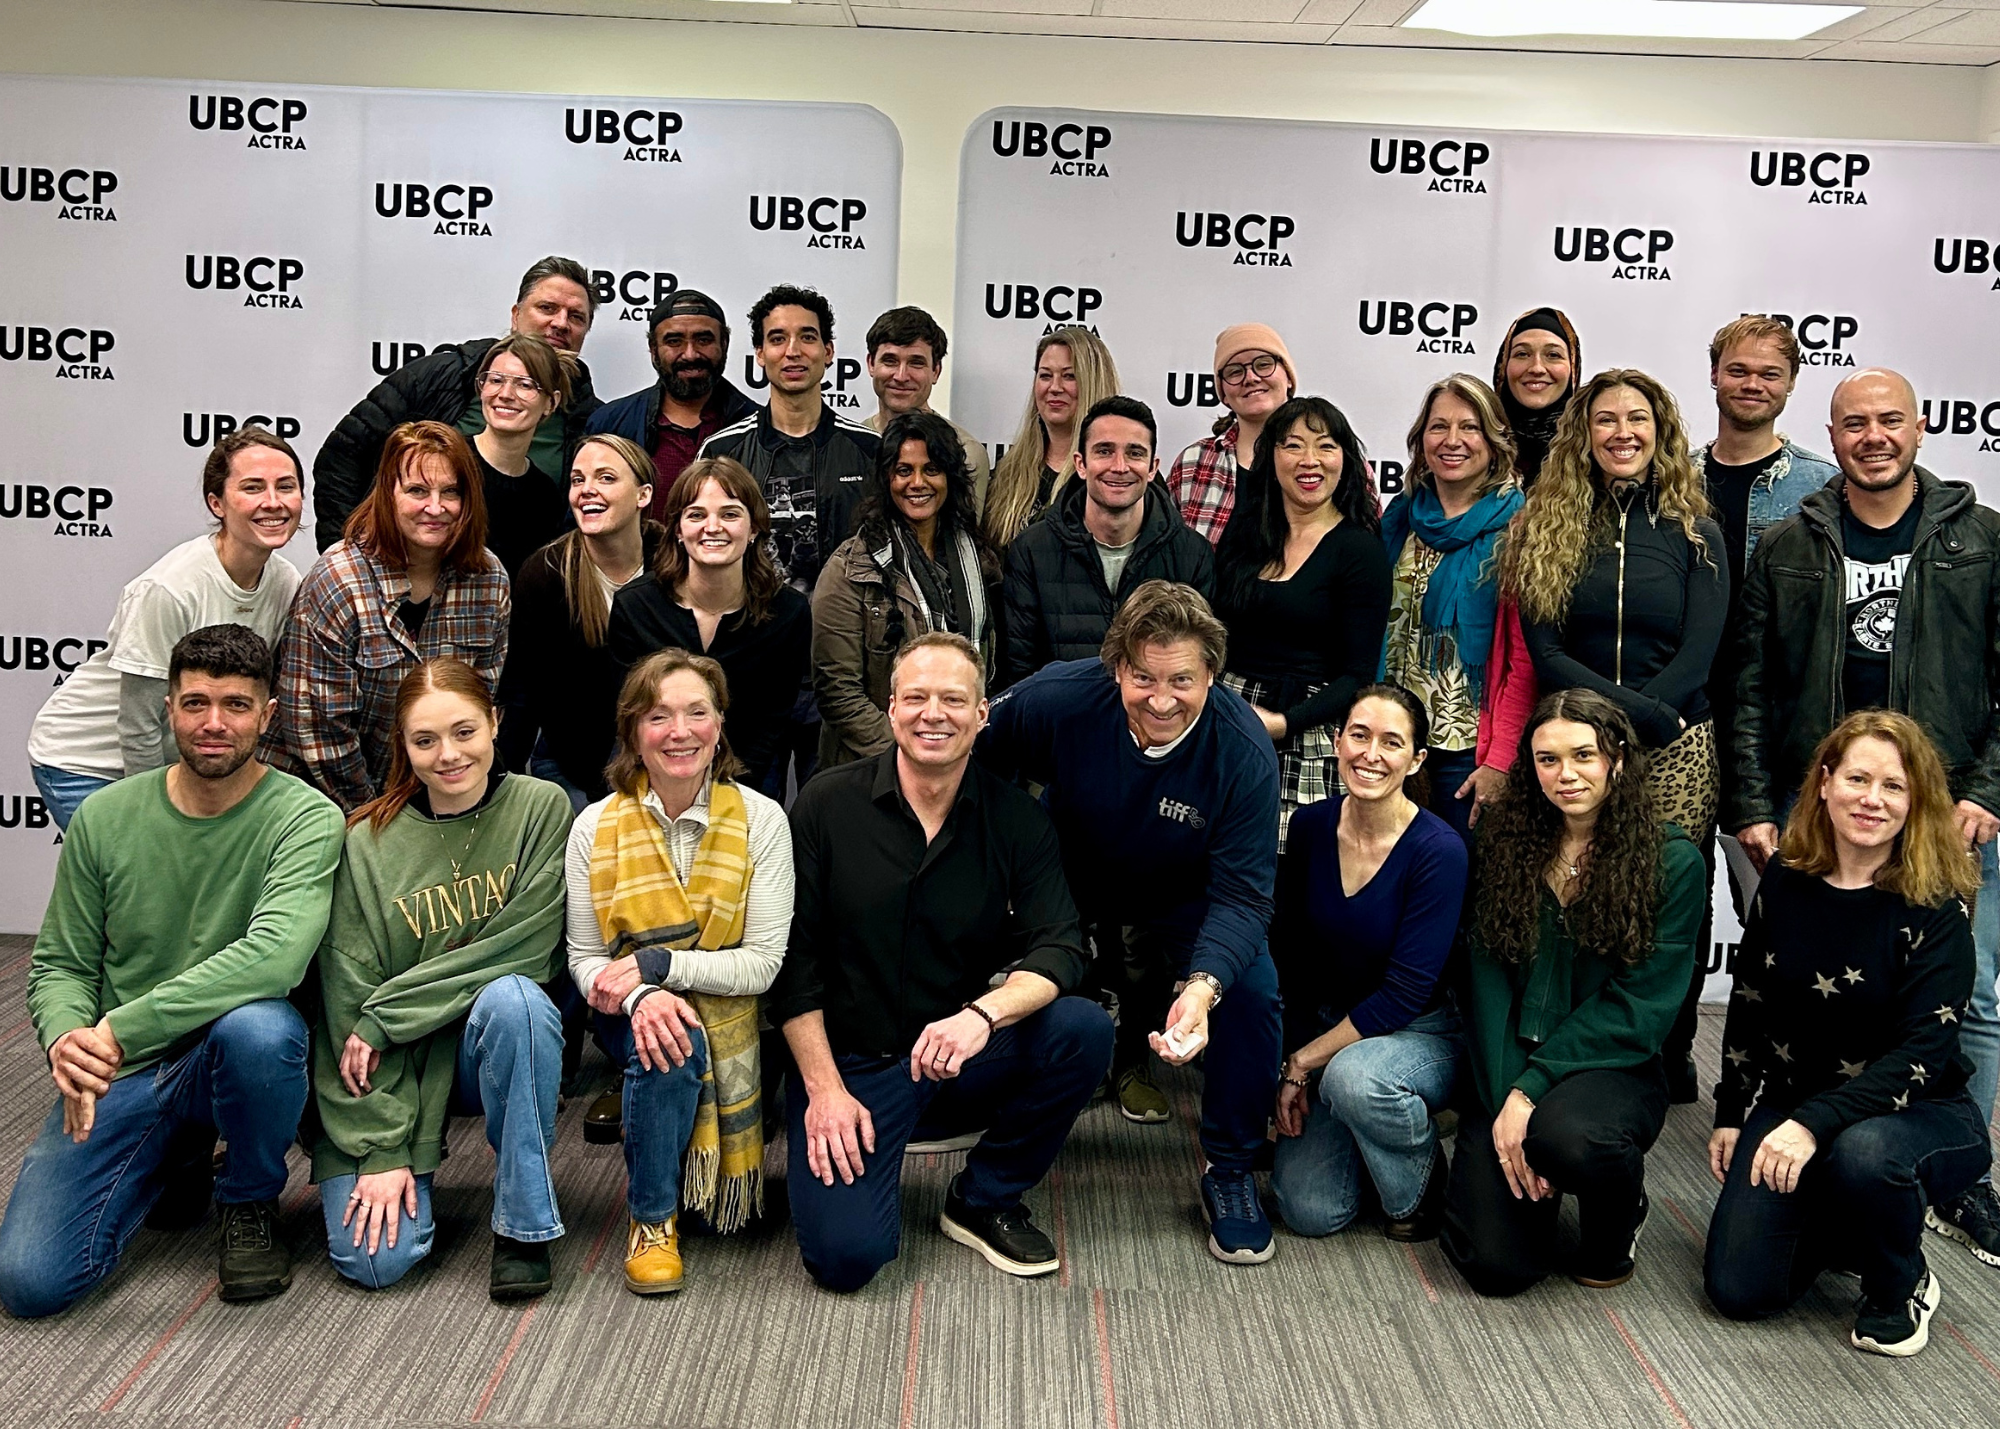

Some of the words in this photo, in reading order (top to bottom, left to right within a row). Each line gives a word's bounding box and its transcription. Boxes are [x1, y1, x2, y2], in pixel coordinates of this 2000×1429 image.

[190, 95, 307, 133] UBCP
[566, 108, 683, 146] UBCP
[248, 134, 308, 151] ACTRA
[623, 147, 683, 163] ACTRA
[992, 120, 1112, 161] UBCP
[1050, 160, 1110, 178] ACTRA
[1370, 138, 1490, 177] UBCP
[1750, 151, 1870, 188] UBCP
[0, 166, 118, 205] UBCP
[376, 182, 493, 220] UBCP
[1427, 177, 1488, 194] ACTRA
[1808, 189, 1869, 206] ACTRA
[58, 205, 118, 222] ACTRA
[433, 221, 493, 237] ACTRA
[749, 195, 867, 233] UBCP
[807, 234, 866, 250] ACTRA
[1176, 211, 1295, 250] UBCP
[1554, 226, 1674, 264] UBCP
[186, 254, 304, 293] UBCP
[1233, 250, 1293, 267] ACTRA
[1611, 266, 1672, 281] ACTRA
[244, 293, 304, 310] ACTRA
[985, 283, 1103, 322] UBCP
[1359, 300, 1478, 338] UBCP
[1741, 313, 1858, 350] CP
[0, 325, 115, 363] UBCP
[372, 341, 458, 376] UB
[1416, 339, 1476, 355] ACTRA
[1798, 351, 1857, 367] ACTRA
[56, 364, 115, 380] ACTRA
[821, 393, 861, 408] TRA
[0, 484, 113, 521] UBCP
[54, 521, 113, 538] ACTRA
[1158, 796, 1191, 823] tiff
